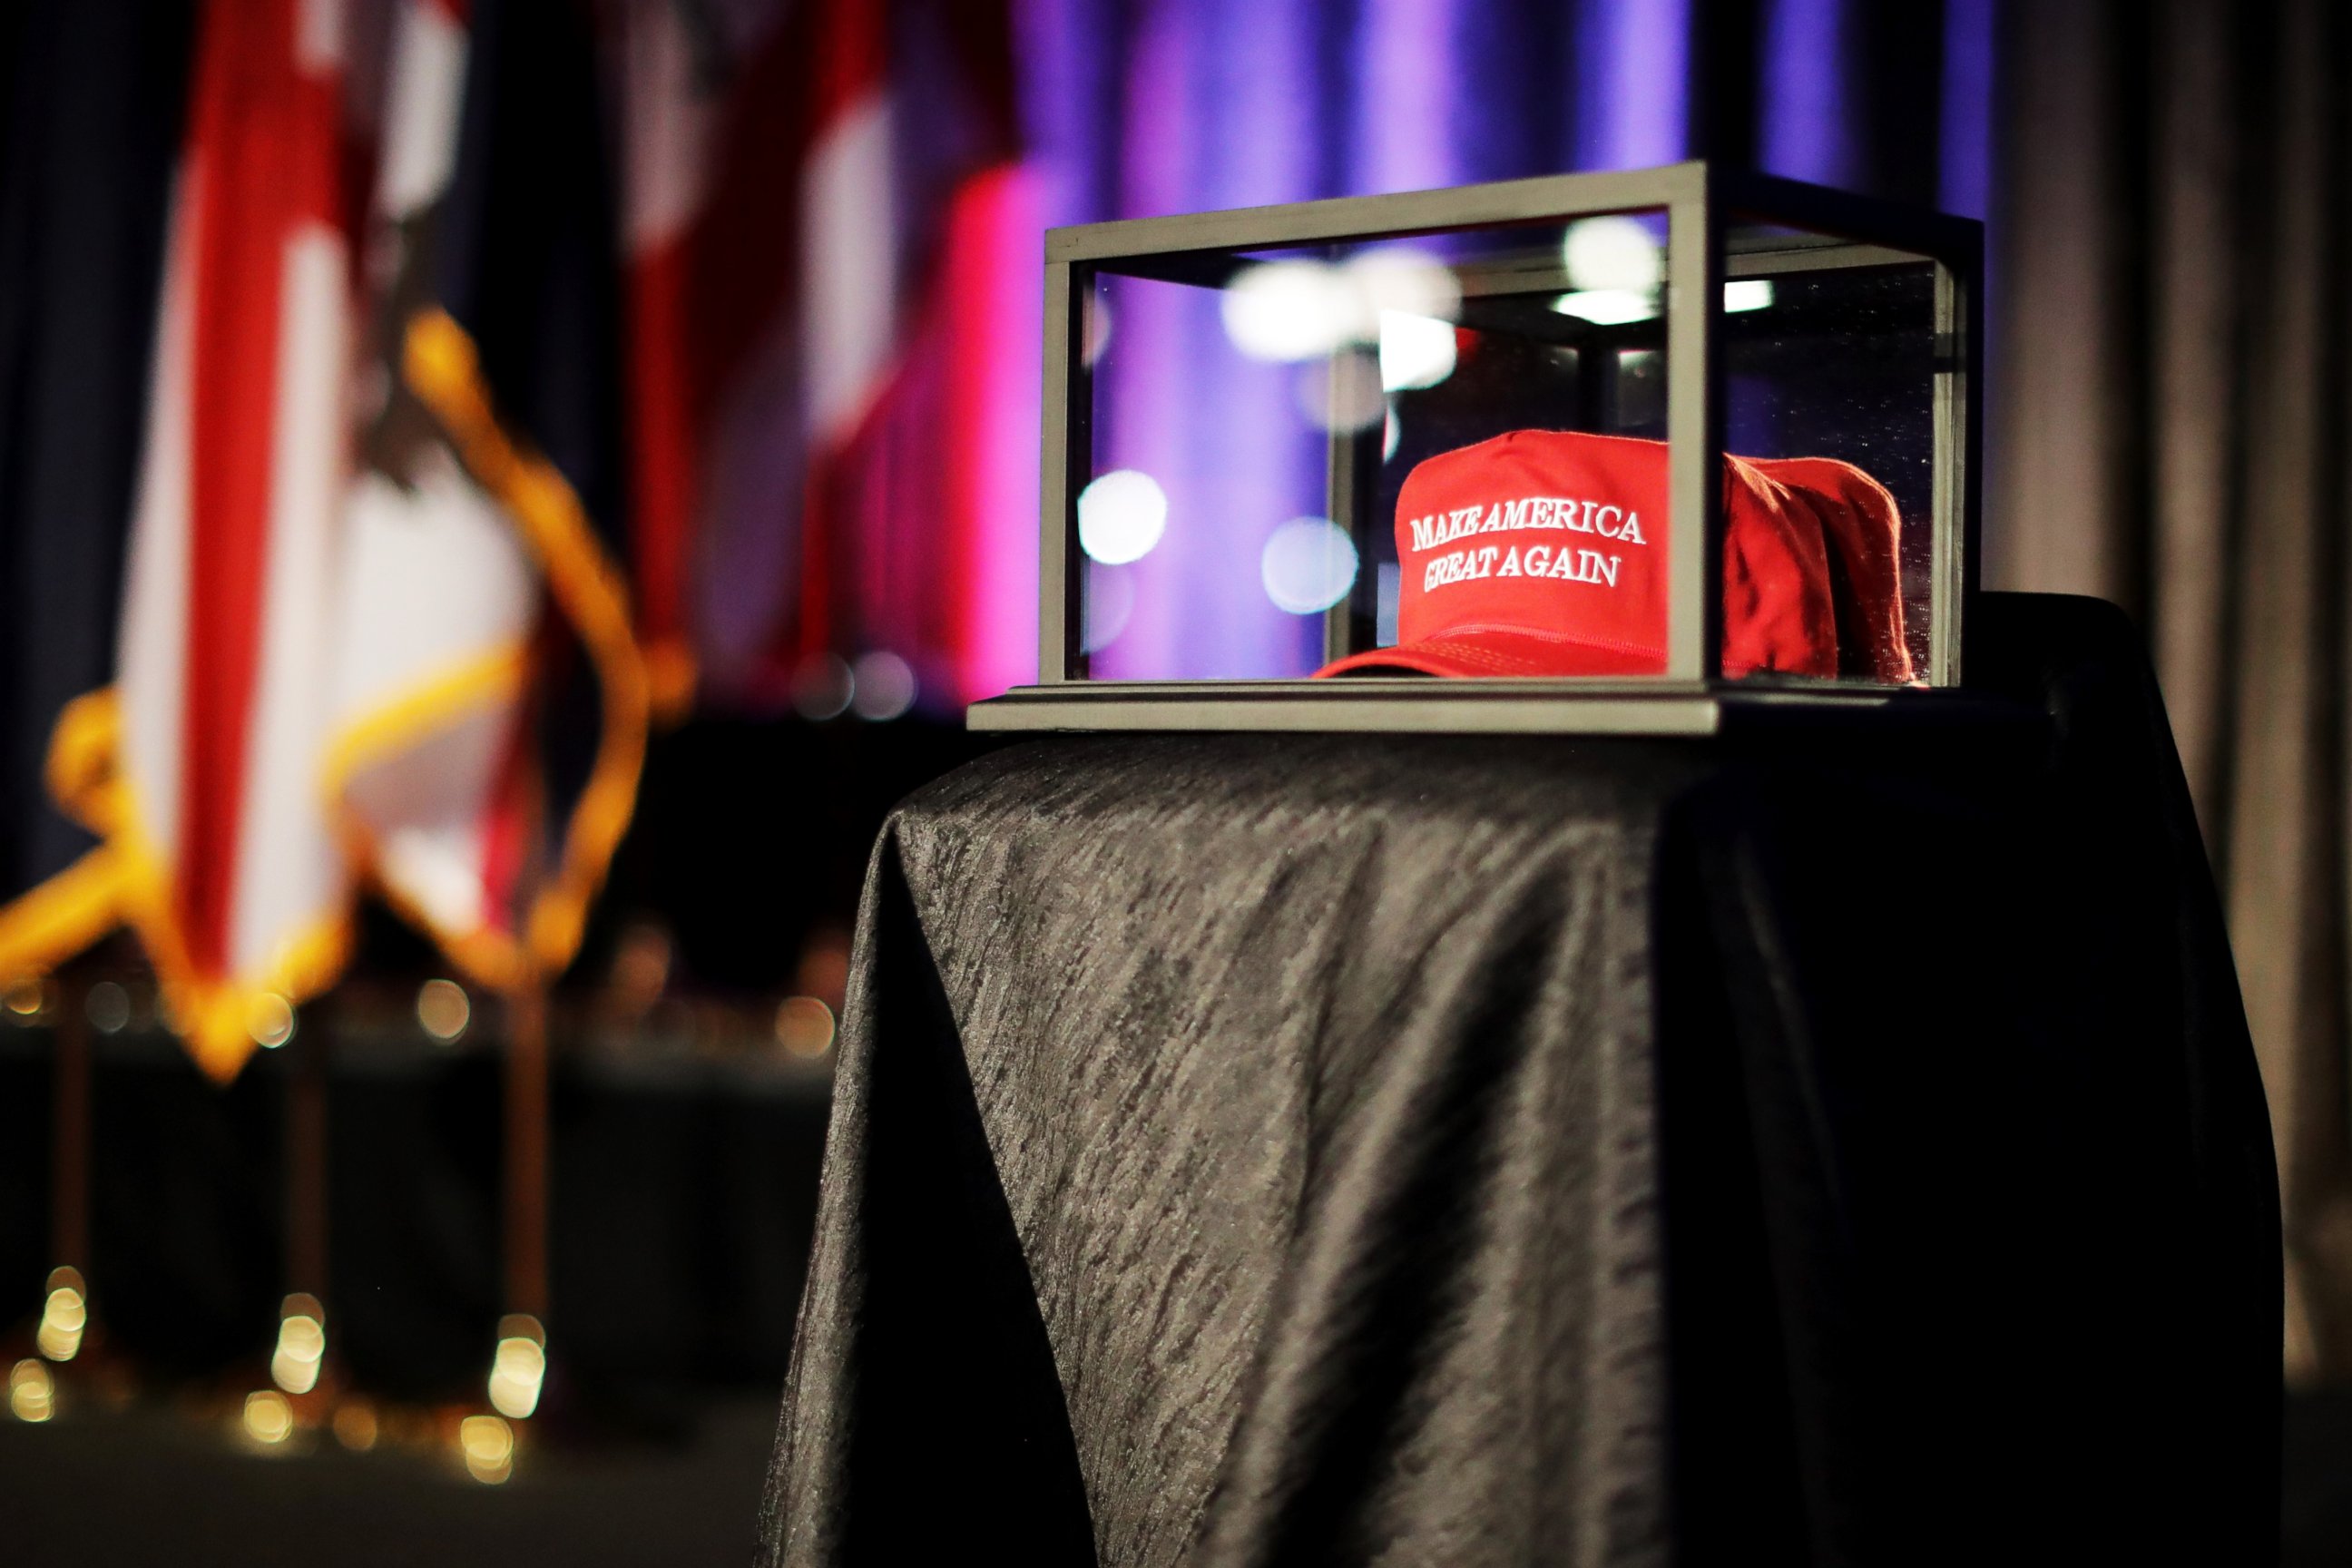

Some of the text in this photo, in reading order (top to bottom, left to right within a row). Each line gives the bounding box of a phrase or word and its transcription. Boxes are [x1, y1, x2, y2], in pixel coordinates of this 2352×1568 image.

[1410, 496, 1647, 552] MAKE AMERICA
[1423, 545, 1621, 593] GREAT AGAIN
